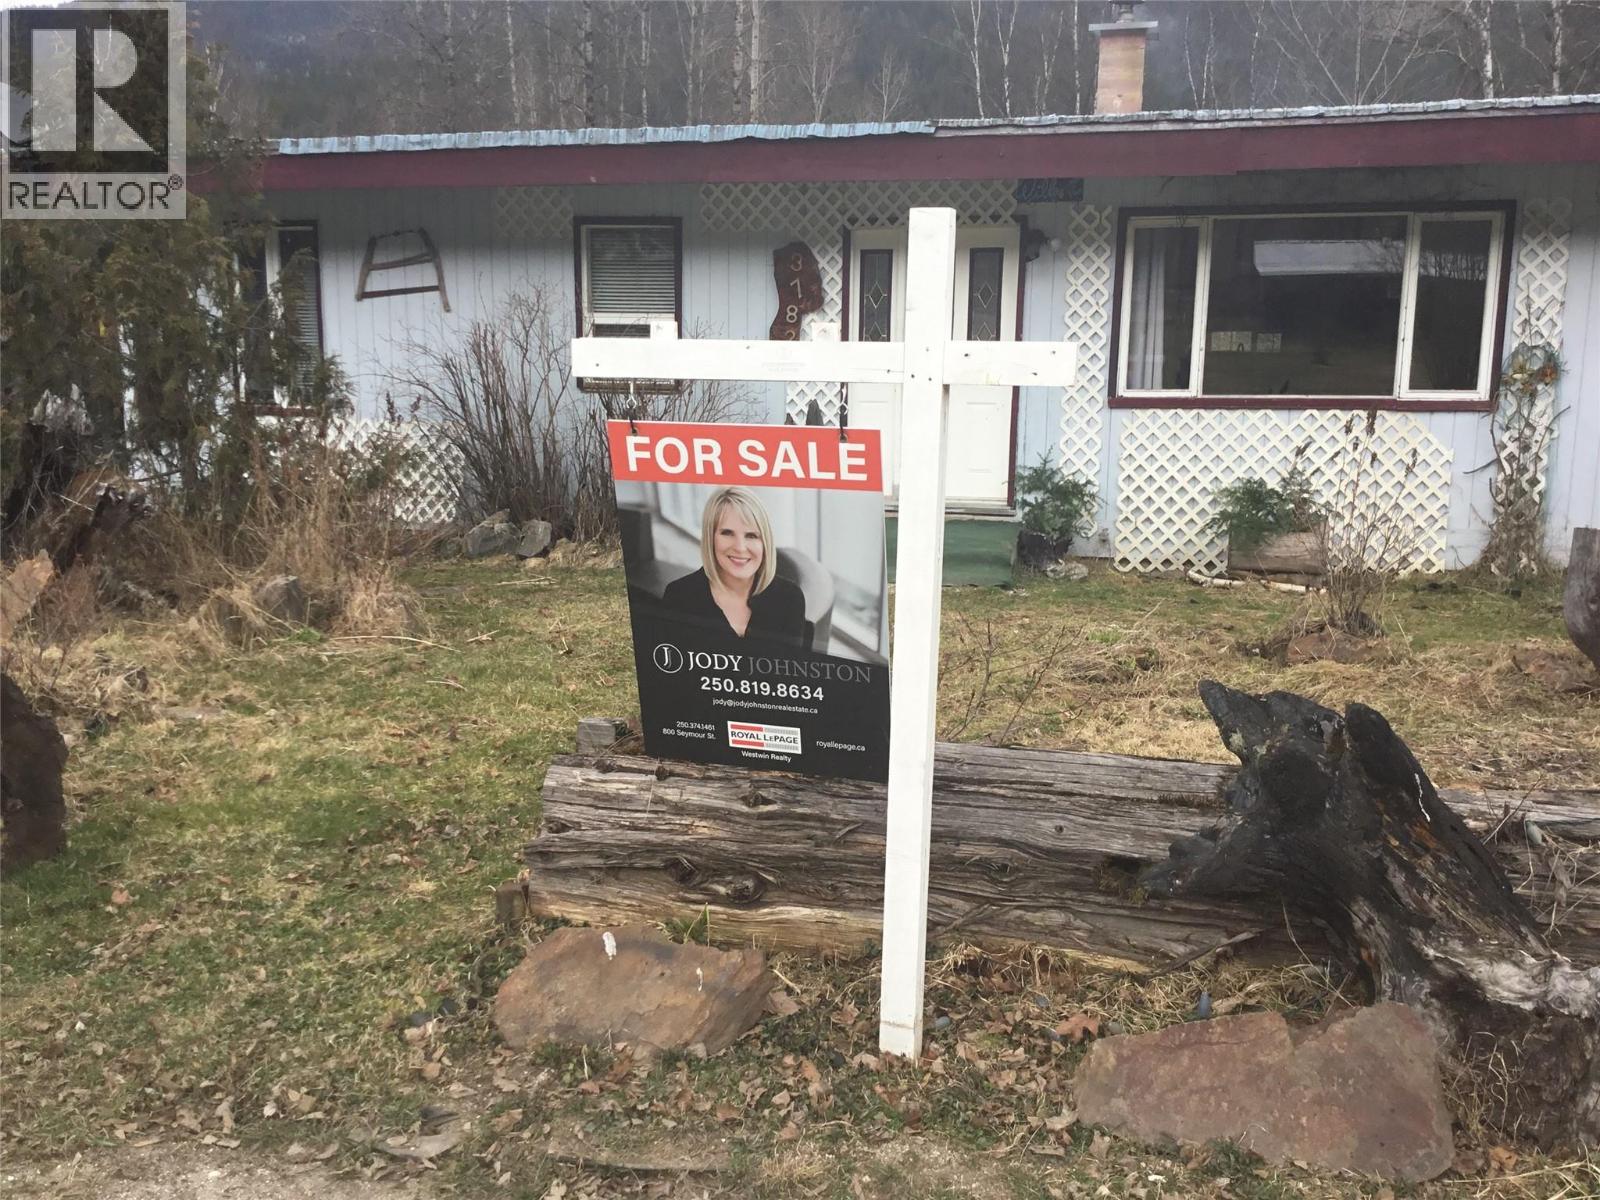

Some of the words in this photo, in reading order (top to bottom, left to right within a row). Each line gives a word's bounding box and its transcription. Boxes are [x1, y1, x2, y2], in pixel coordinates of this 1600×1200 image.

[625, 435, 723, 476] FOR
[738, 439, 868, 481] SALE
[688, 651, 743, 672] JODY
[749, 656, 872, 683] JOHNSTON
[700, 676, 824, 701] 250.819.8634
[712, 698, 818, 715] jody@jodyjohnstonrealestate.ca
[662, 727, 676, 736] 800
[676, 728, 704, 739] Seymour
[705, 731, 716, 740] St.
[731, 730, 762, 741] ROYAL
[816, 740, 865, 752] royallepage.ca
[741, 750, 770, 761] Westwin
[770, 752, 792, 763] Realty
